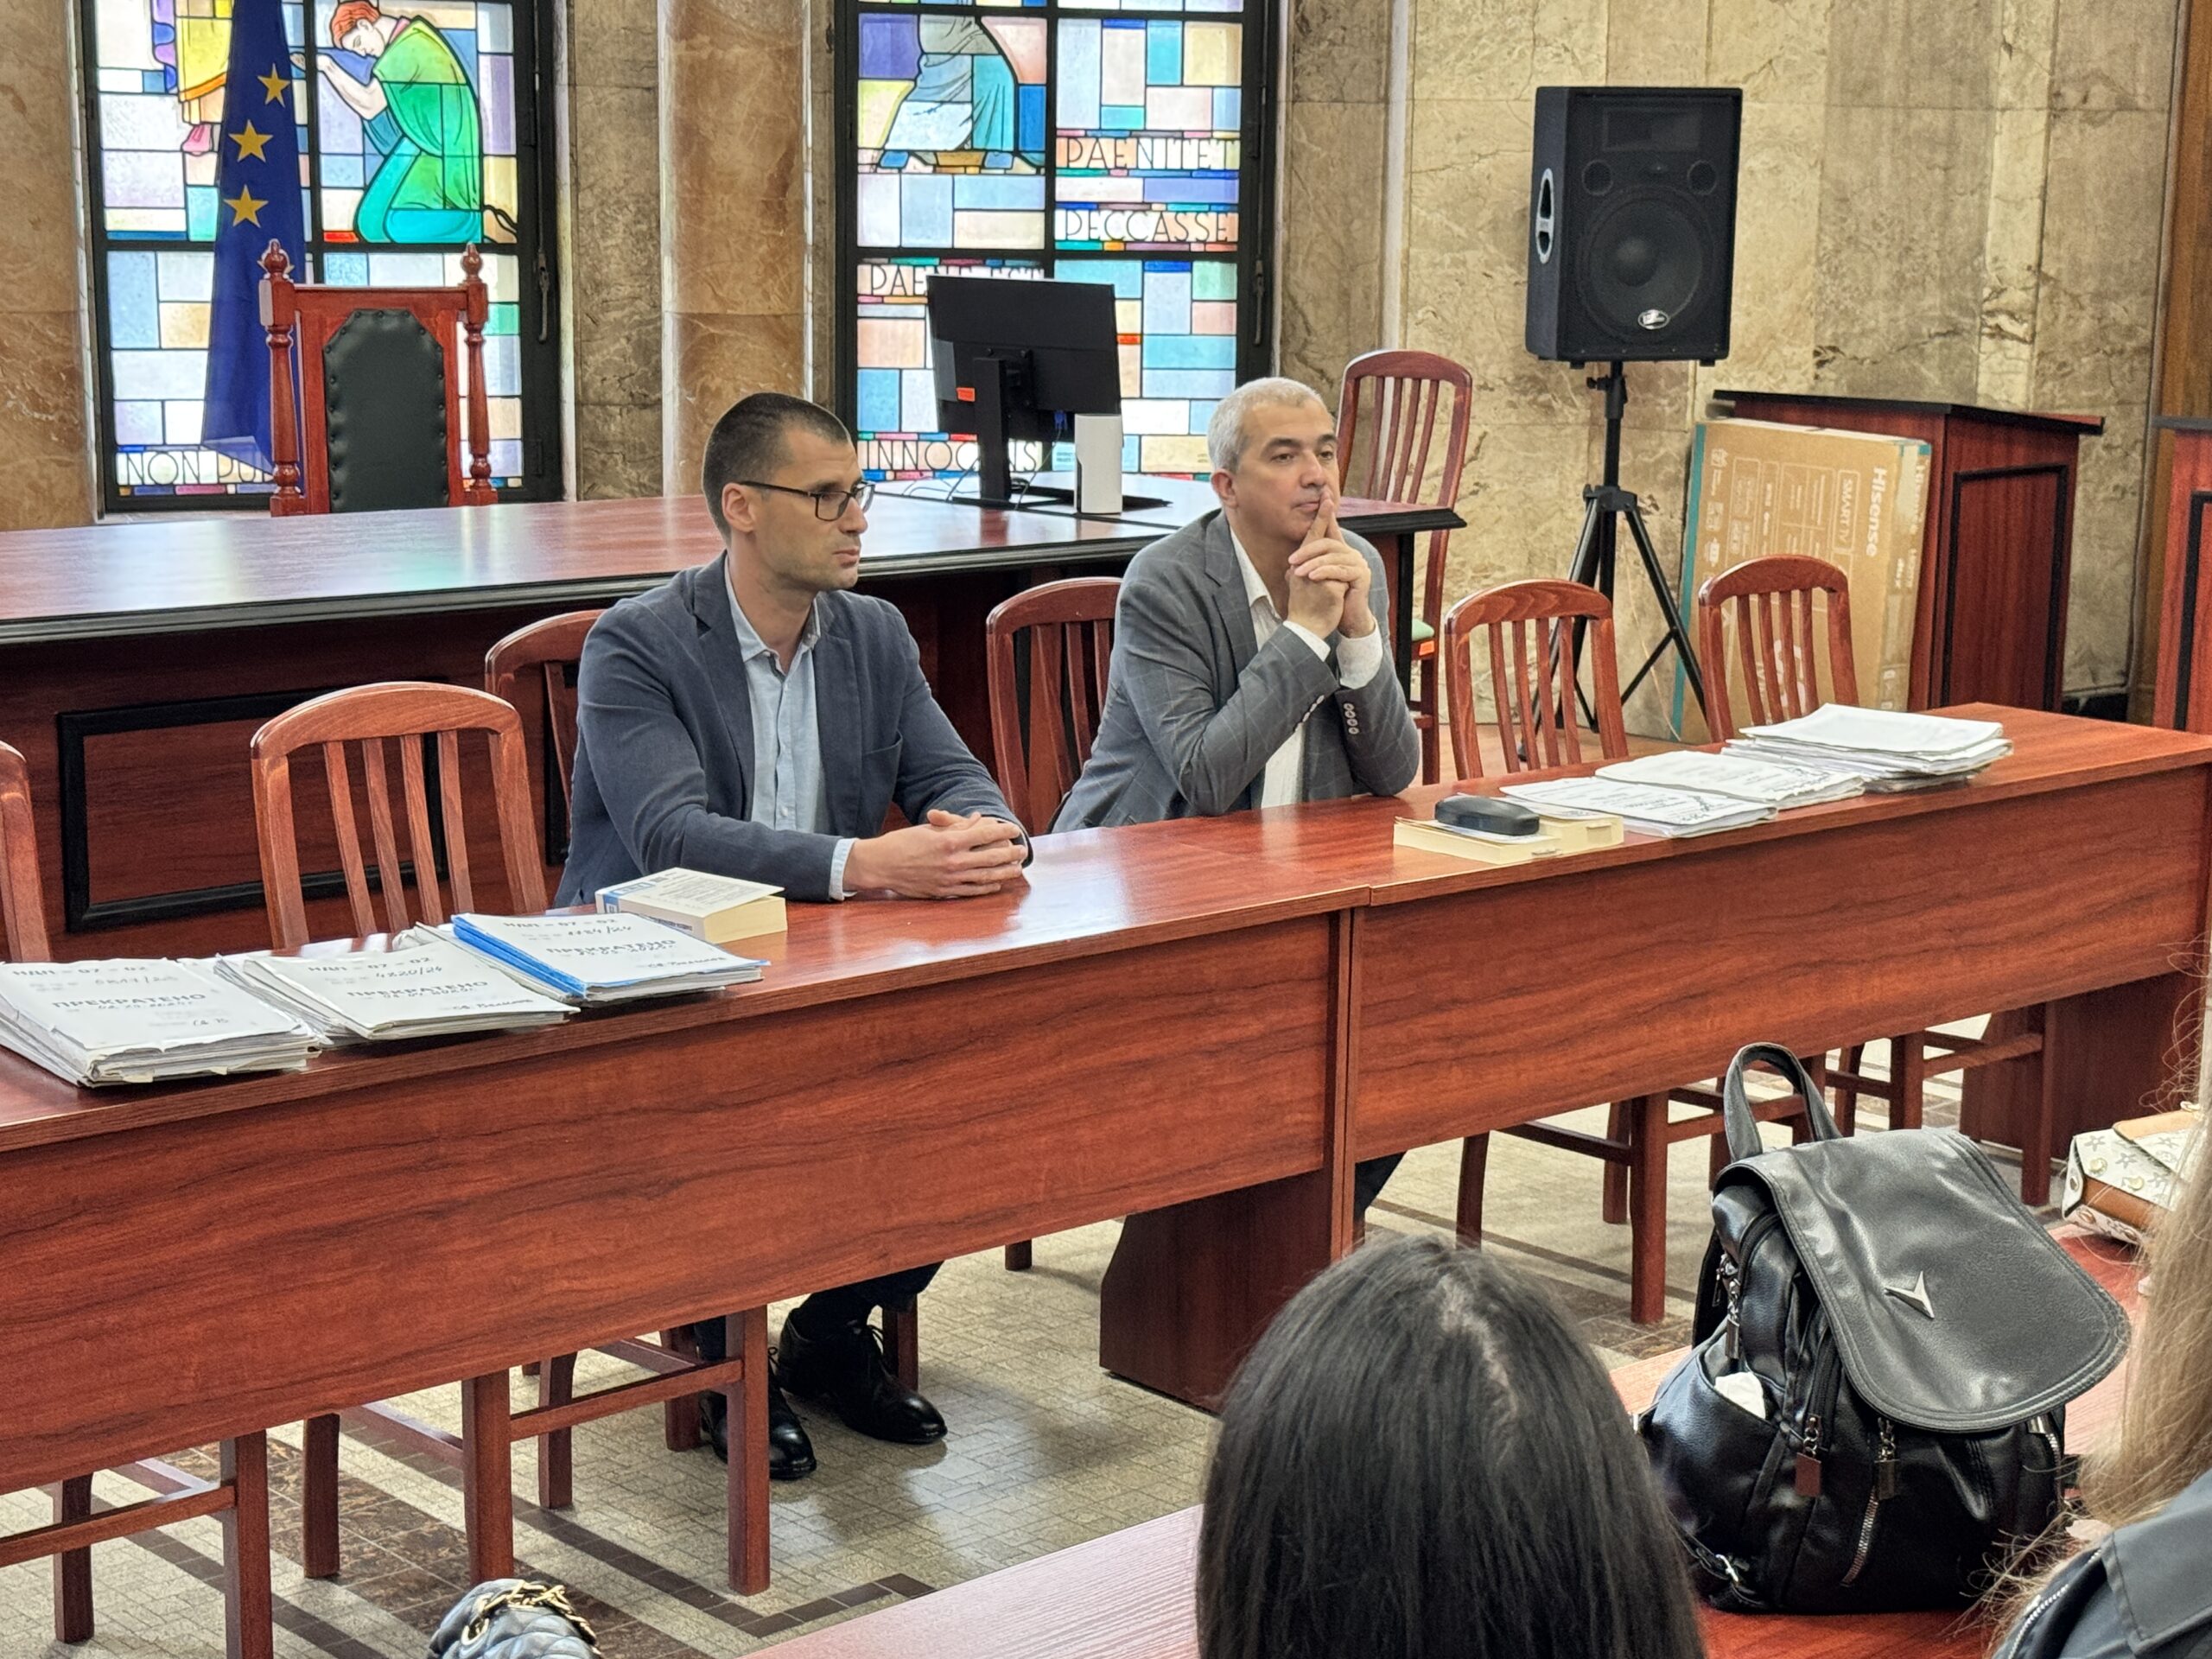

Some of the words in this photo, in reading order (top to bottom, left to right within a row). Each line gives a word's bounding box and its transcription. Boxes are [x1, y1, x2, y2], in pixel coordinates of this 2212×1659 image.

[1065, 209, 1229, 243] PECCASSE
[126, 449, 200, 486] NON
[1840, 478, 1853, 526] SMART
[1866, 466, 1888, 558] Hisense
[1839, 528, 1850, 543] TV
[52, 993, 207, 1008] ПРЕКРАТЕНО
[346, 981, 489, 996] ПРЕКРАТЕНО
